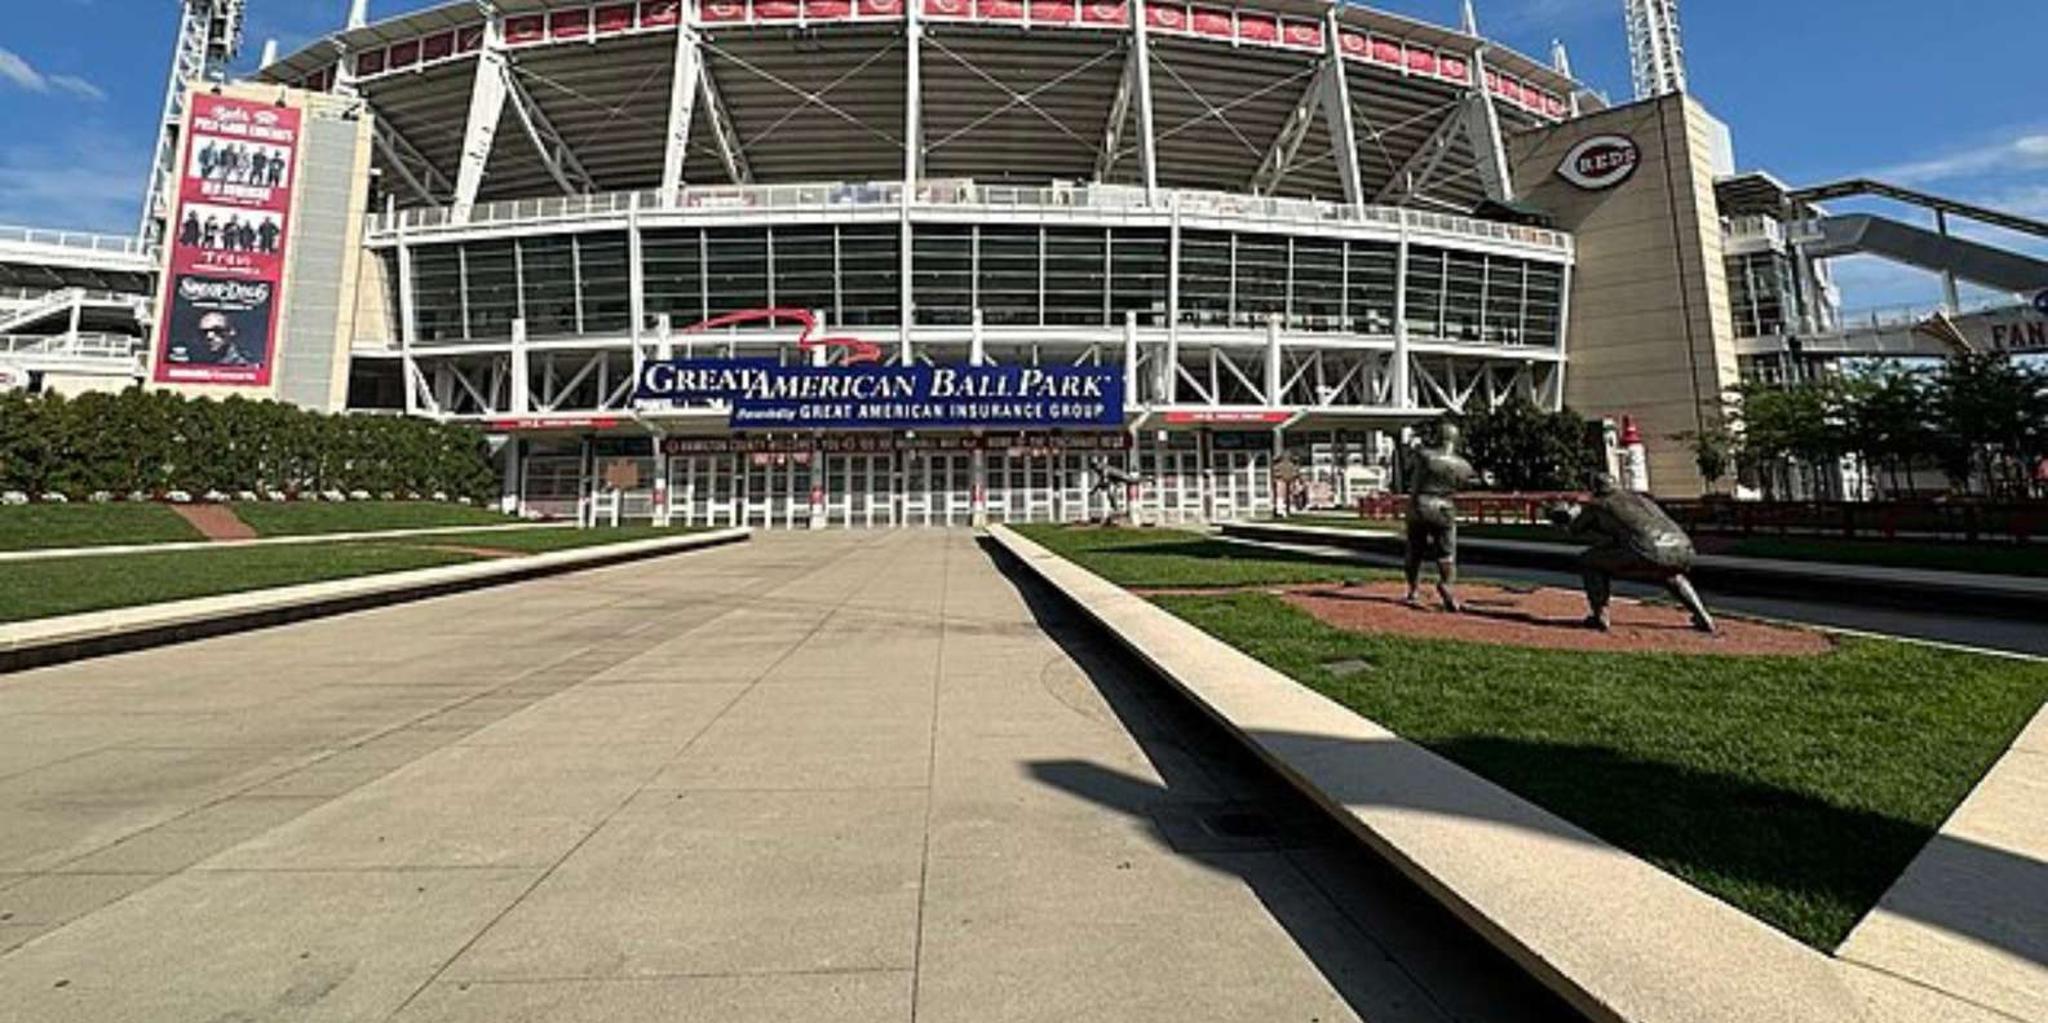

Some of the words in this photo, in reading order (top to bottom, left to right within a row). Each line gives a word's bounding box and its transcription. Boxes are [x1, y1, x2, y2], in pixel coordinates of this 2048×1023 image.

[1579, 148, 1637, 173] REDS
[645, 363, 758, 393] GREAT
[744, 367, 916, 399] AMERICAN
[930, 368, 1013, 397] BALL
[1016, 368, 1103, 397] PARK
[799, 403, 853, 419] GREAT
[857, 403, 942, 419] AMERICAN
[949, 403, 1043, 419] INSURANCE
[1049, 403, 1105, 419] GROUP
